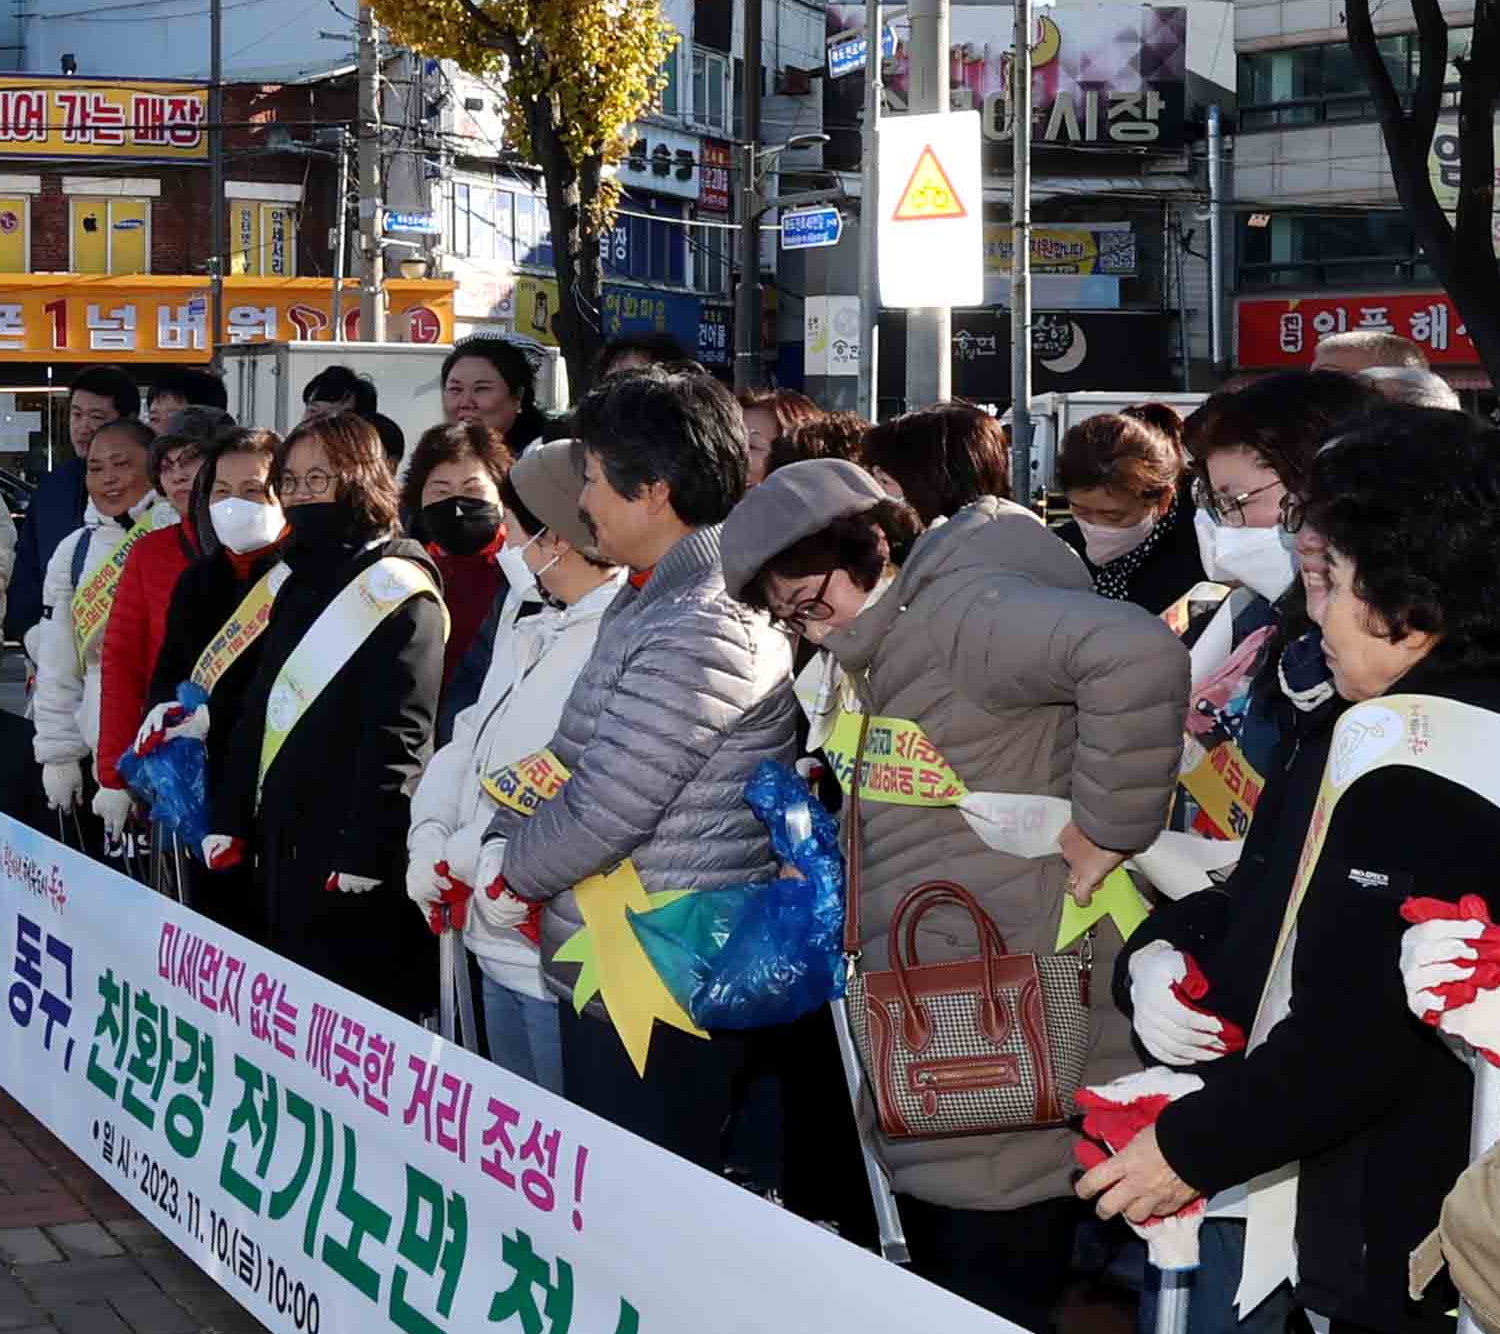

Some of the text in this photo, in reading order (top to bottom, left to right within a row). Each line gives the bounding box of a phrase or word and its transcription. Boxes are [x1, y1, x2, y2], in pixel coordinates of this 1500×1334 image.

[57, 95, 124, 144] 가는
[134, 97, 202, 147] 매장
[8, 912, 75, 1073] 동구,
[86, 968, 214, 1160] 친환경
[158, 921, 248, 1026] 미세먼지
[250, 971, 299, 1060] 없는
[305, 1002, 396, 1117] 깨끗한
[402, 1053, 473, 1163] 거리
